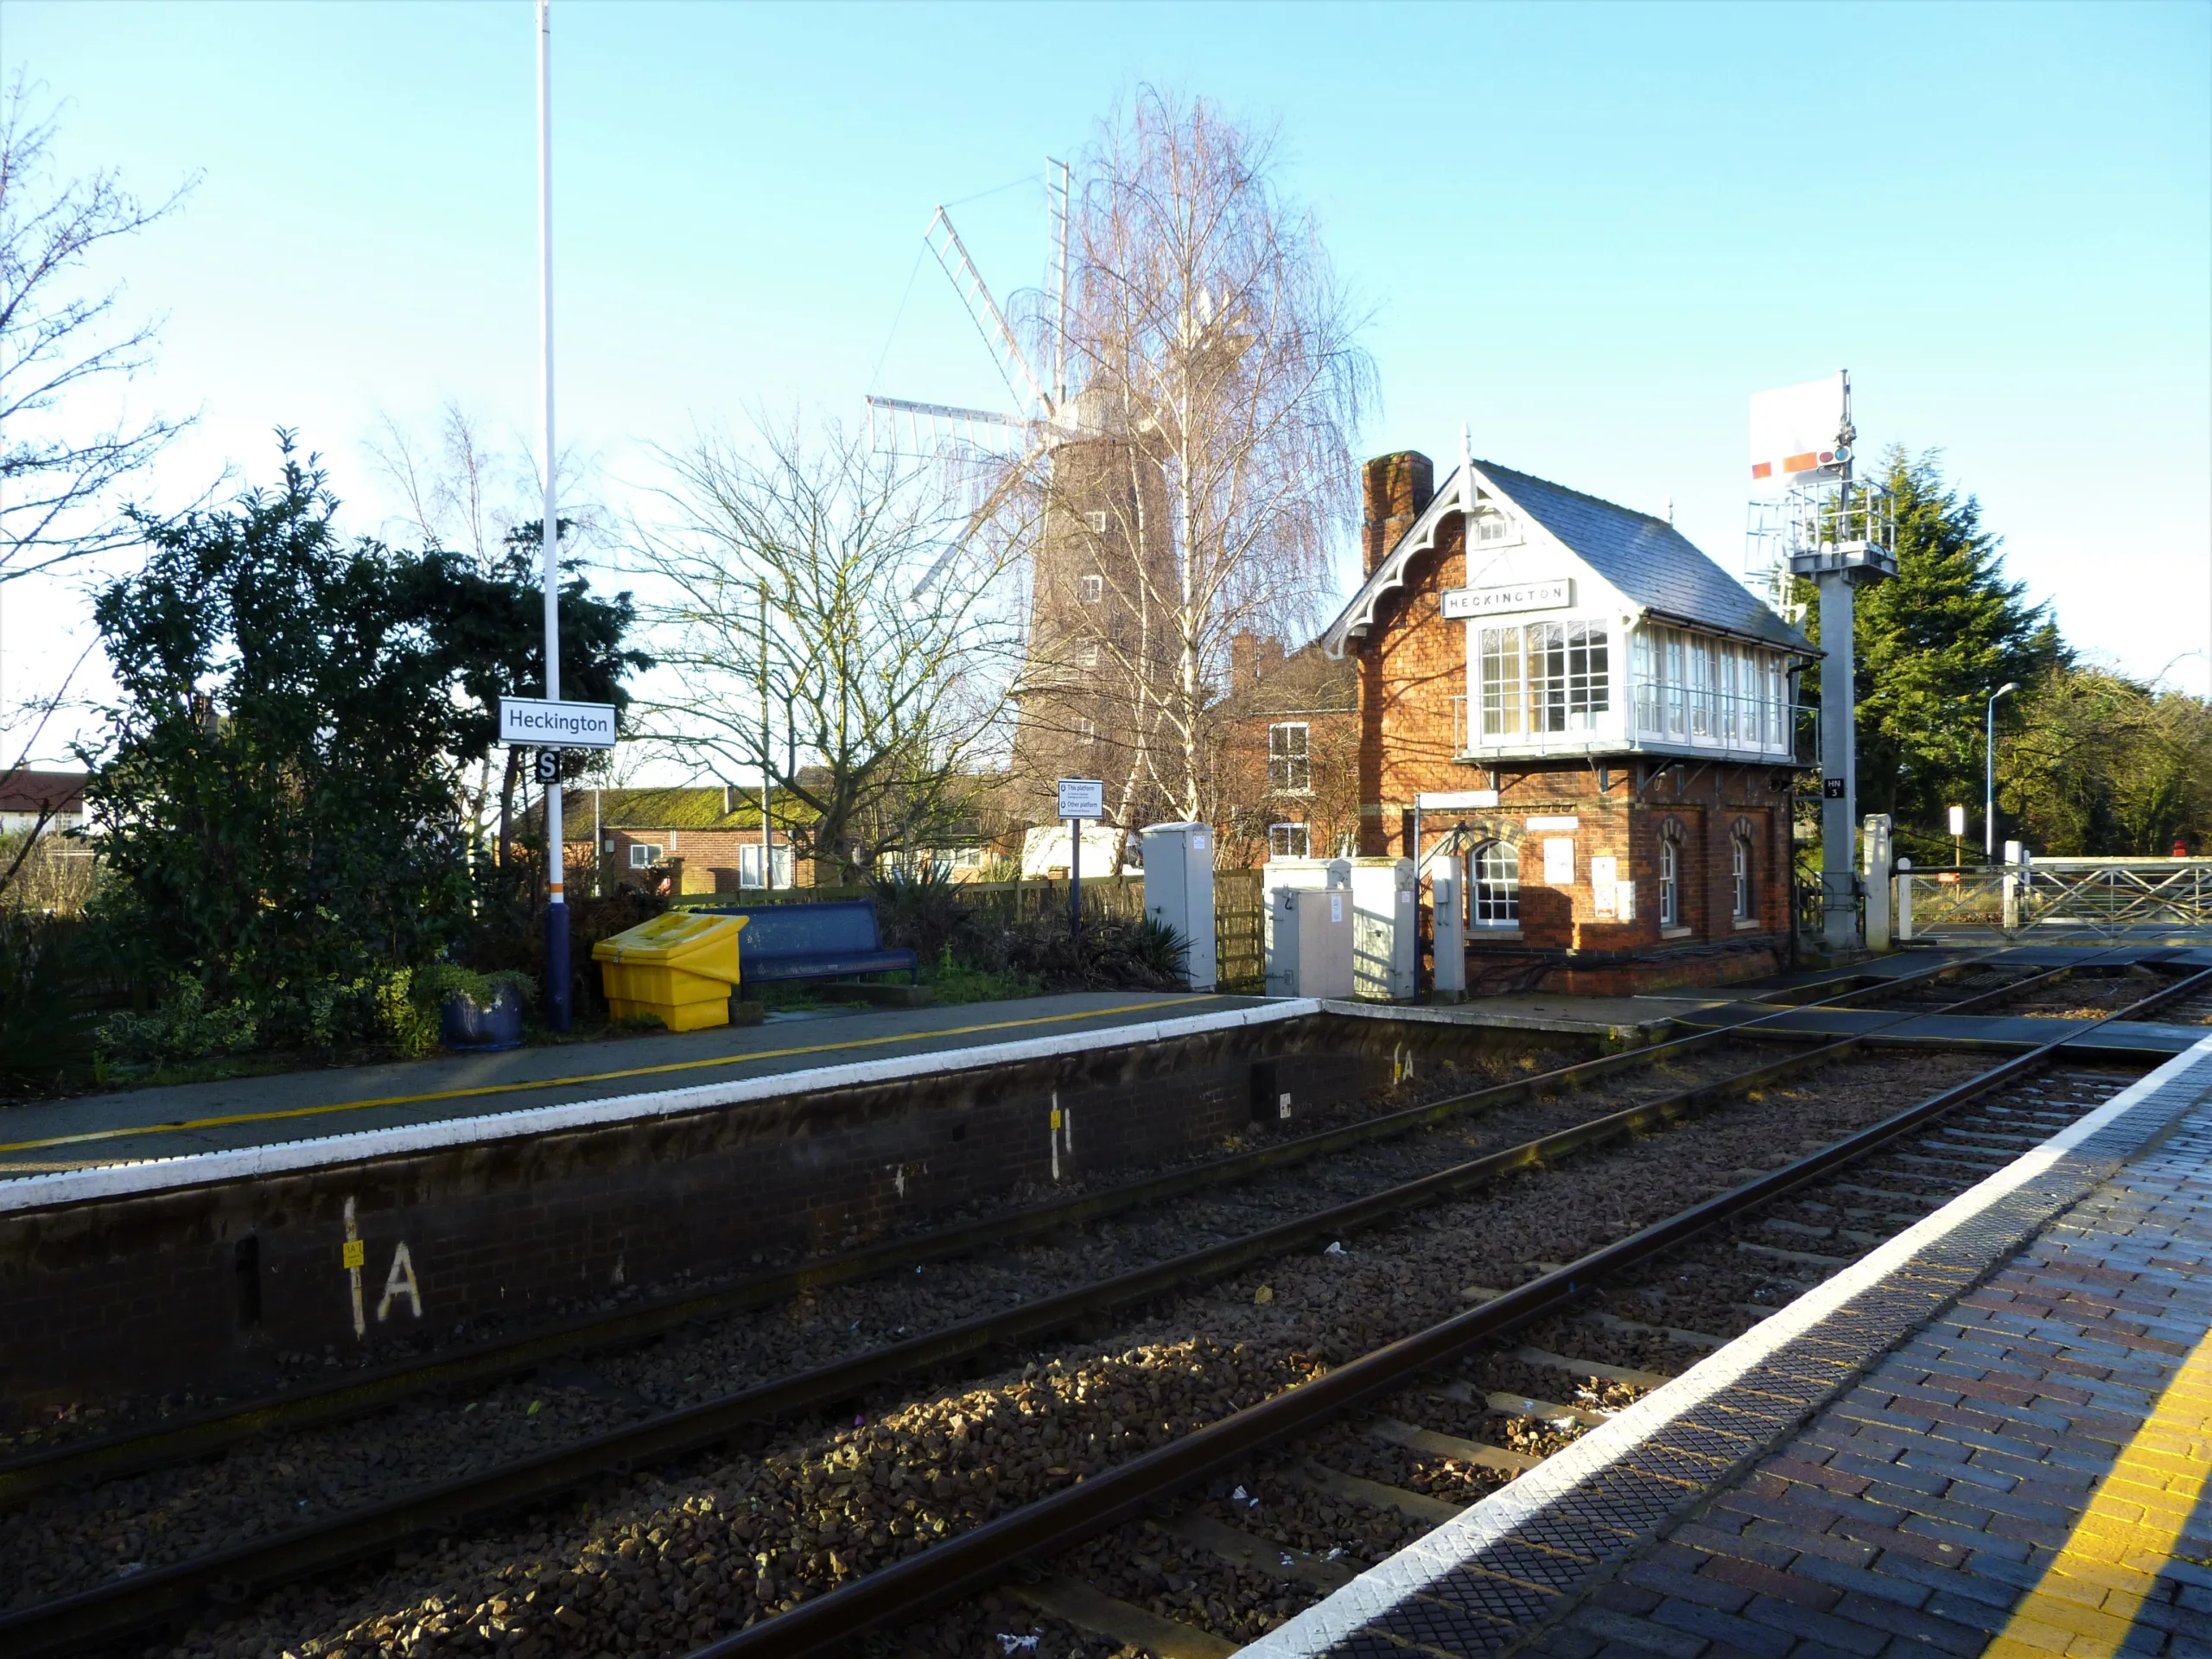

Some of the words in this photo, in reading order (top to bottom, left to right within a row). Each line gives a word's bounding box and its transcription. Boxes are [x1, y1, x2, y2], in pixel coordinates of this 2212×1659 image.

[1450, 588, 1561, 608] HECKINGTON
[509, 709, 608, 734] Heckington
[539, 753, 556, 778] S
